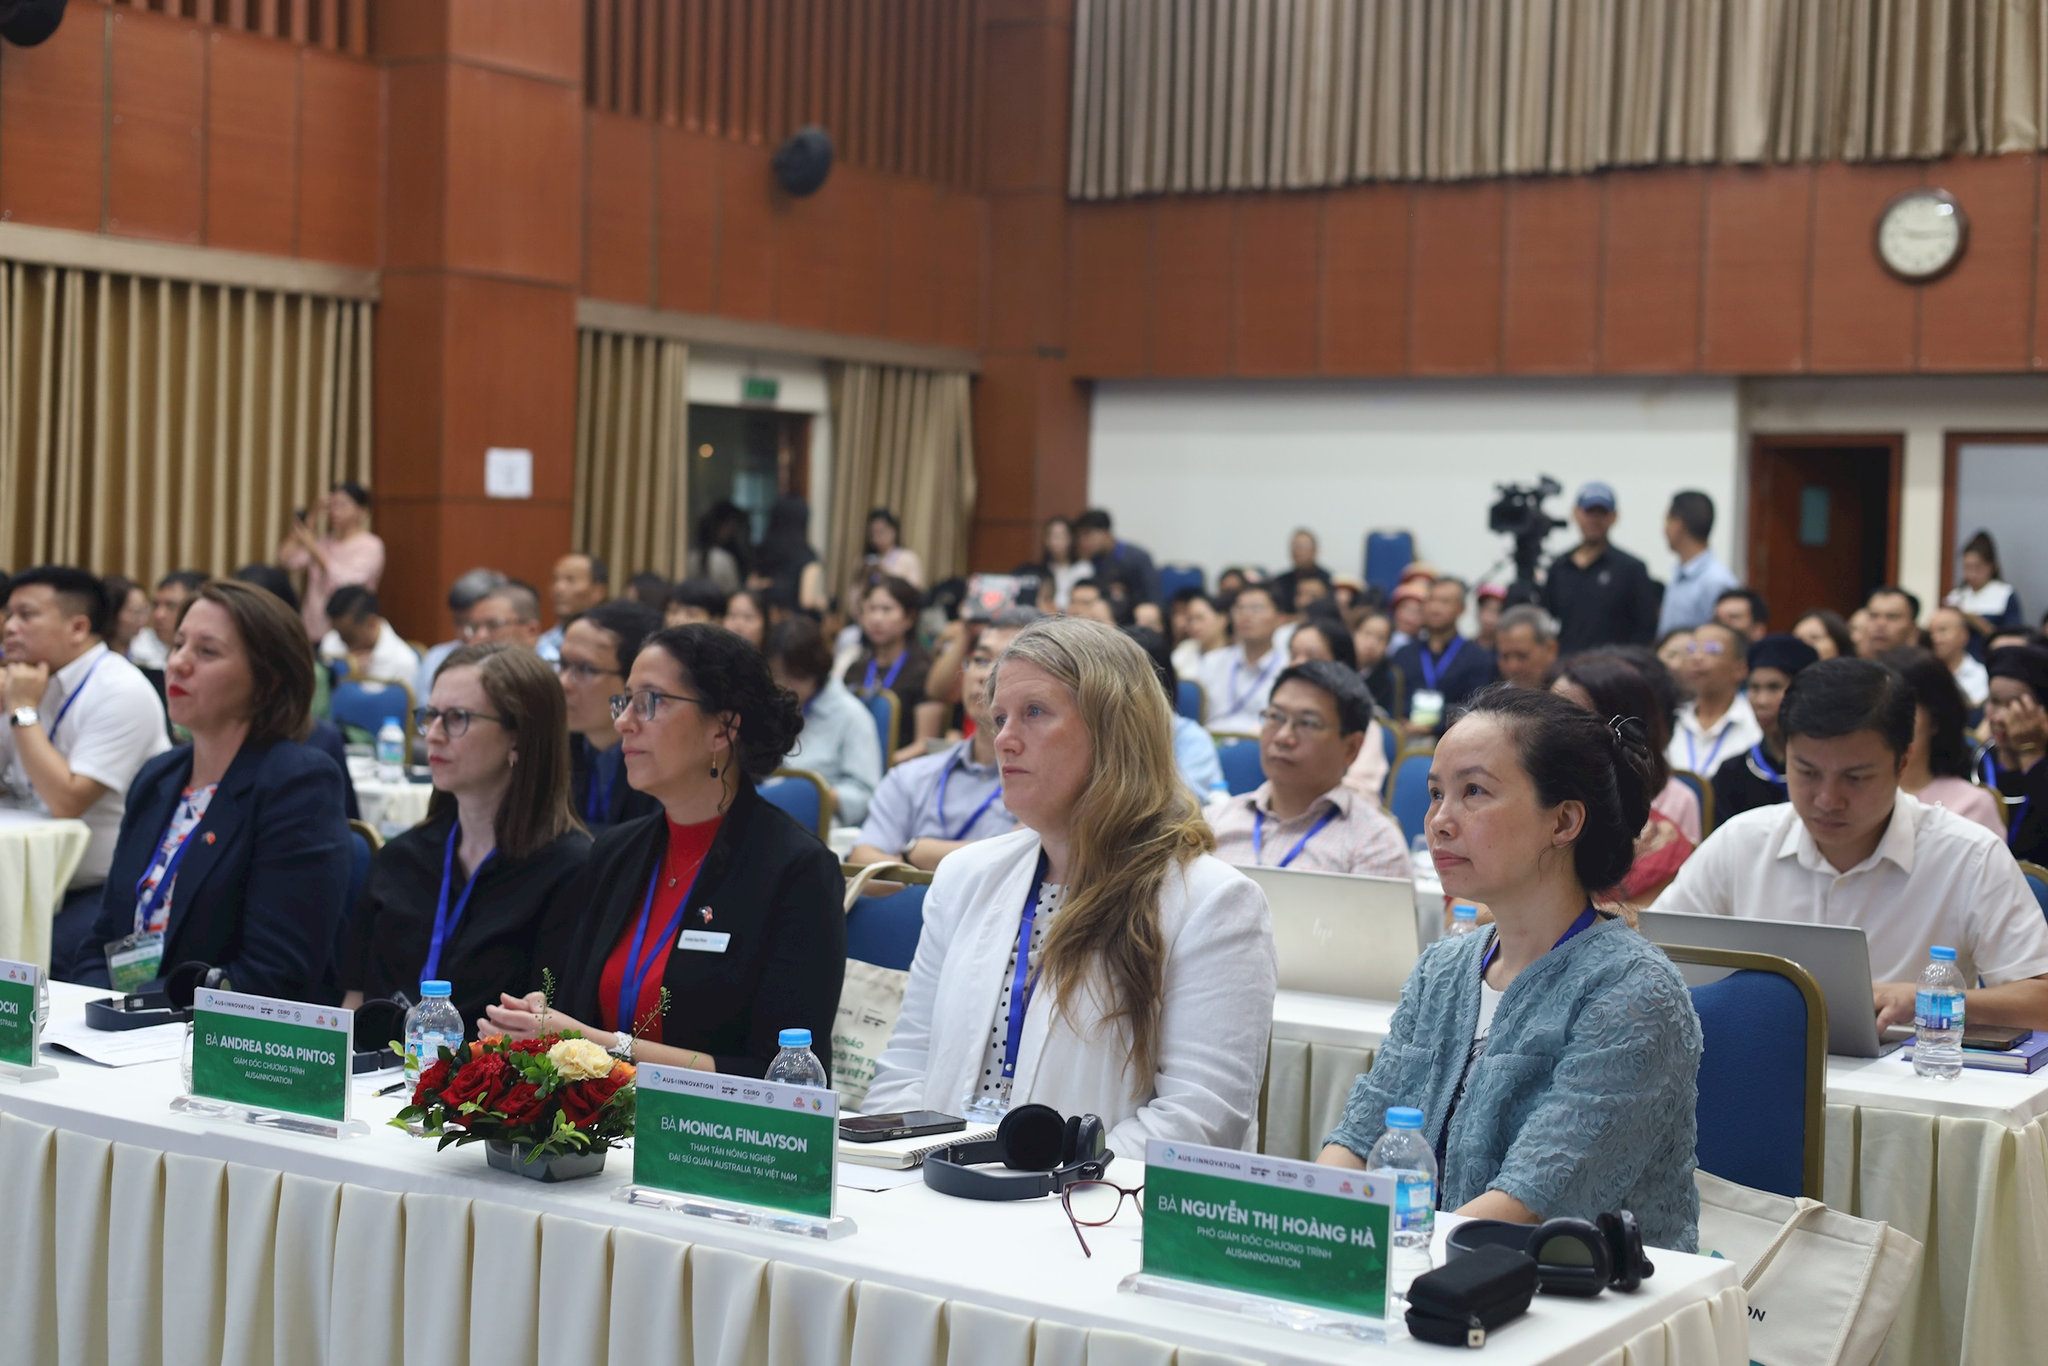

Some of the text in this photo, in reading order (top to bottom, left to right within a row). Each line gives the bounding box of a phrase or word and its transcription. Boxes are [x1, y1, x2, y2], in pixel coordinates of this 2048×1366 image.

[205, 1032, 336, 1065] BÀ ANDREA SOSA PINTOS
[661, 1115, 808, 1153] BÀ MONICA FINLAYSON
[690, 1142, 710, 1153] THAM
[714, 1159, 751, 1174] AUSTRALIA
[780, 1171, 798, 1182] NAM
[1158, 1193, 1376, 1249] BÀ NGUYỄN THỊ HOÀNG HÀ
